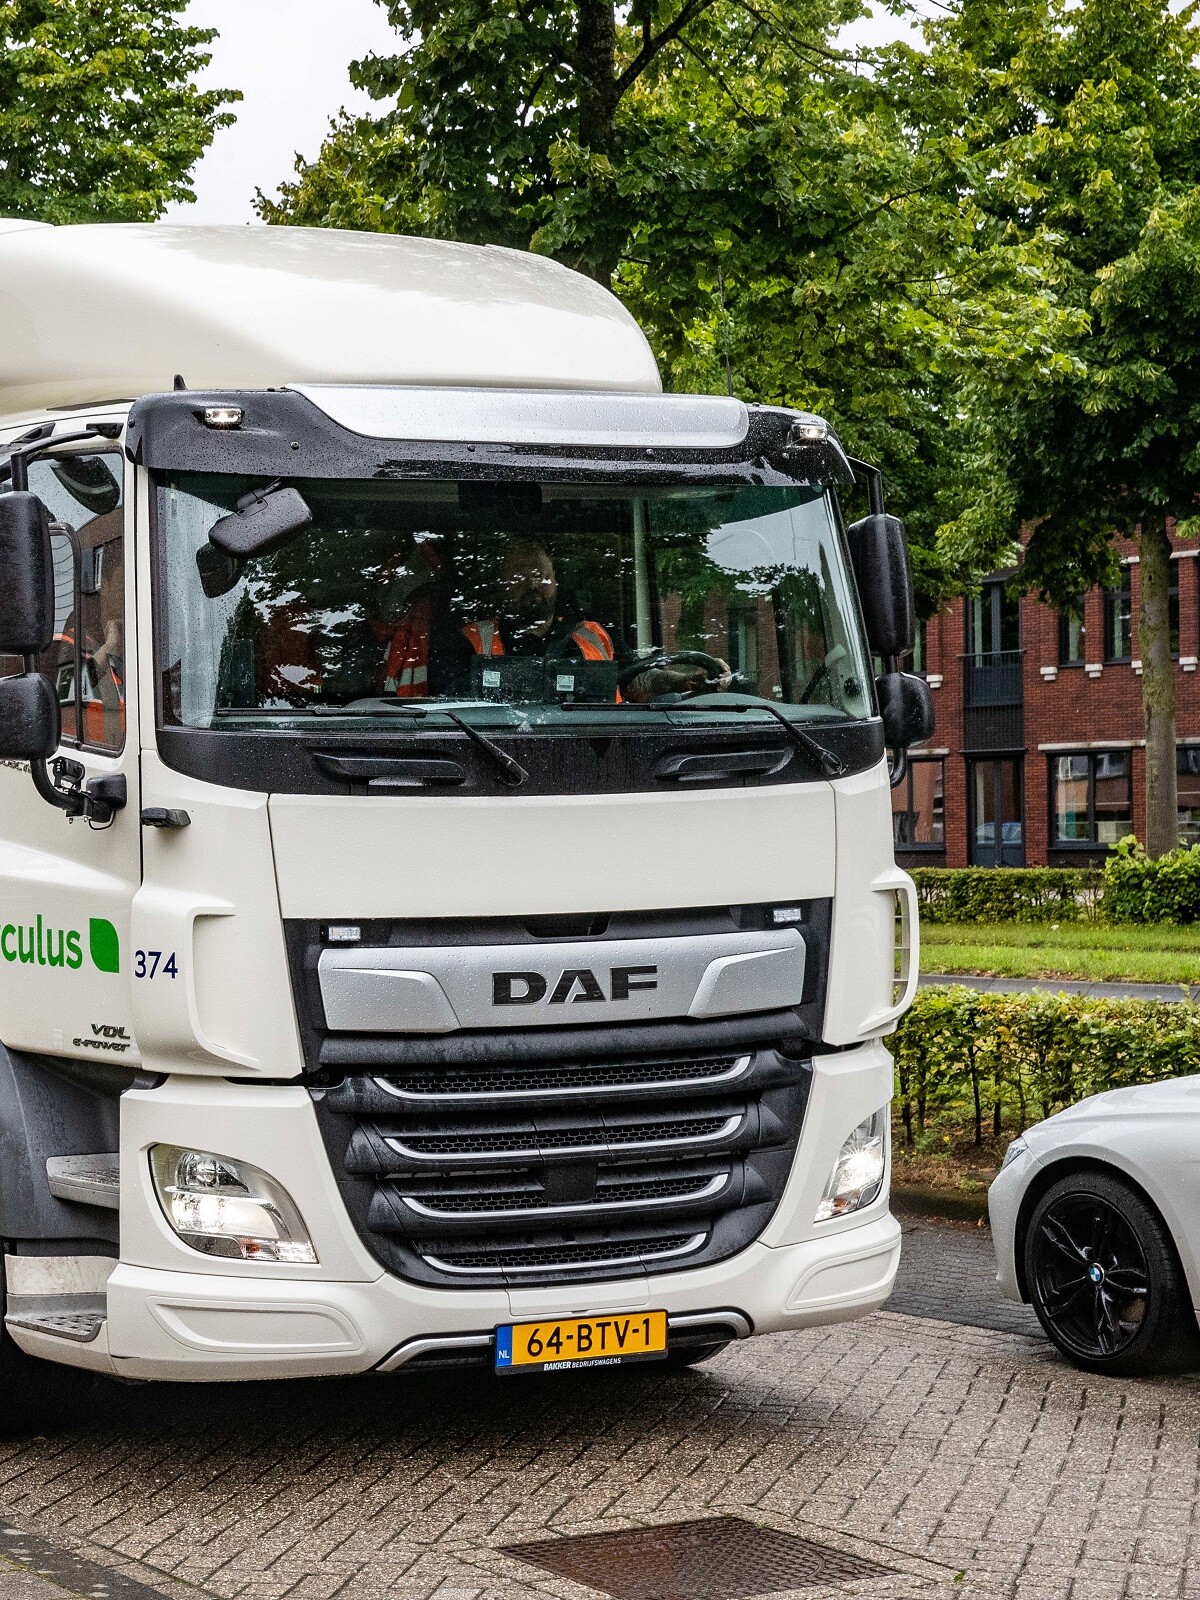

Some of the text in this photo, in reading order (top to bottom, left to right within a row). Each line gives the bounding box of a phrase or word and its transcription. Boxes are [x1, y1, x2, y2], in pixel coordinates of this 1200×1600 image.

[134, 950, 179, 979] 374
[492, 964, 658, 1008] DAF
[91, 1023, 131, 1039] VDL
[527, 1317, 651, 1357] 64-BTV-1
[498, 1350, 510, 1360] NL
[543, 1357, 621, 1371] BAKKER BEDRIJFSWAGENS
